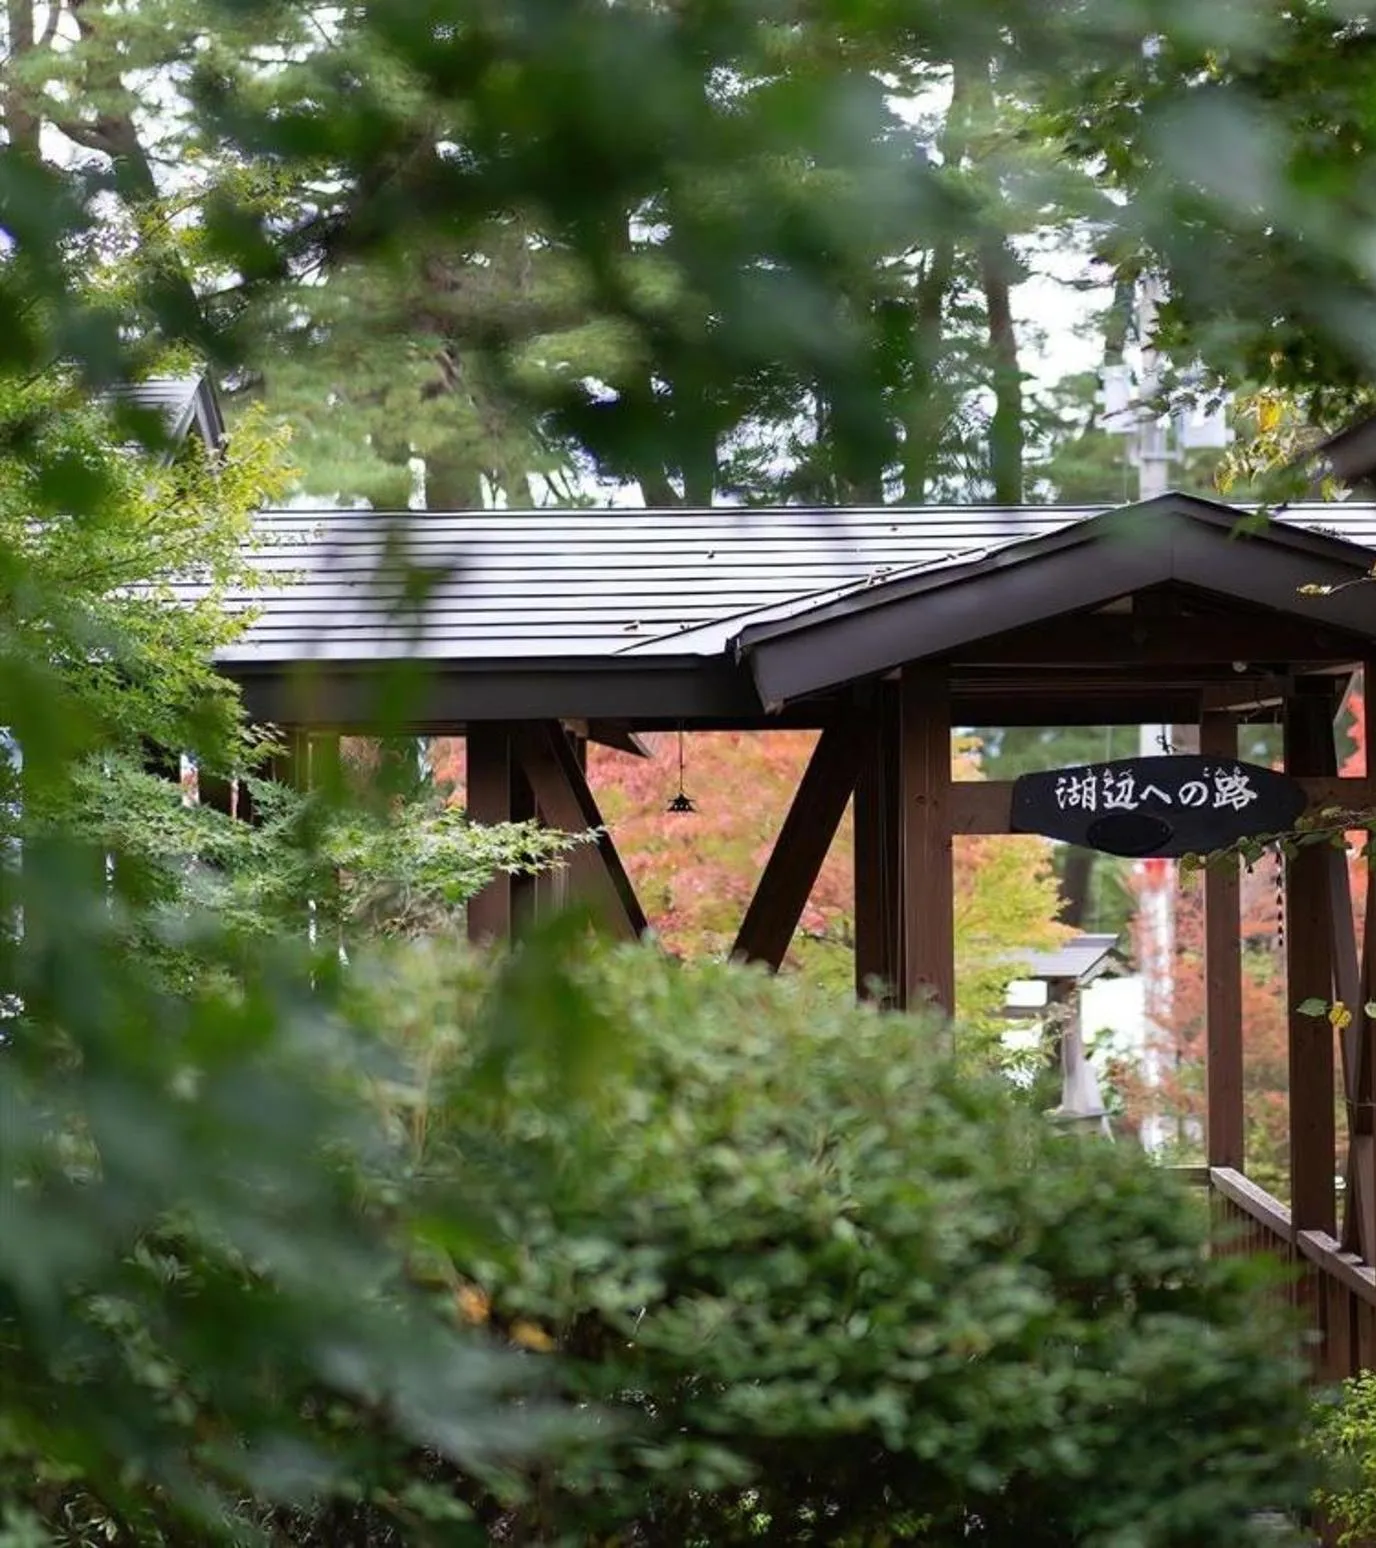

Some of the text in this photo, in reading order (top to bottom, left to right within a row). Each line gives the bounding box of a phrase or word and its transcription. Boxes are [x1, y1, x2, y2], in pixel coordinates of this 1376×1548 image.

[1055, 773, 1258, 811] 湖辺への路
